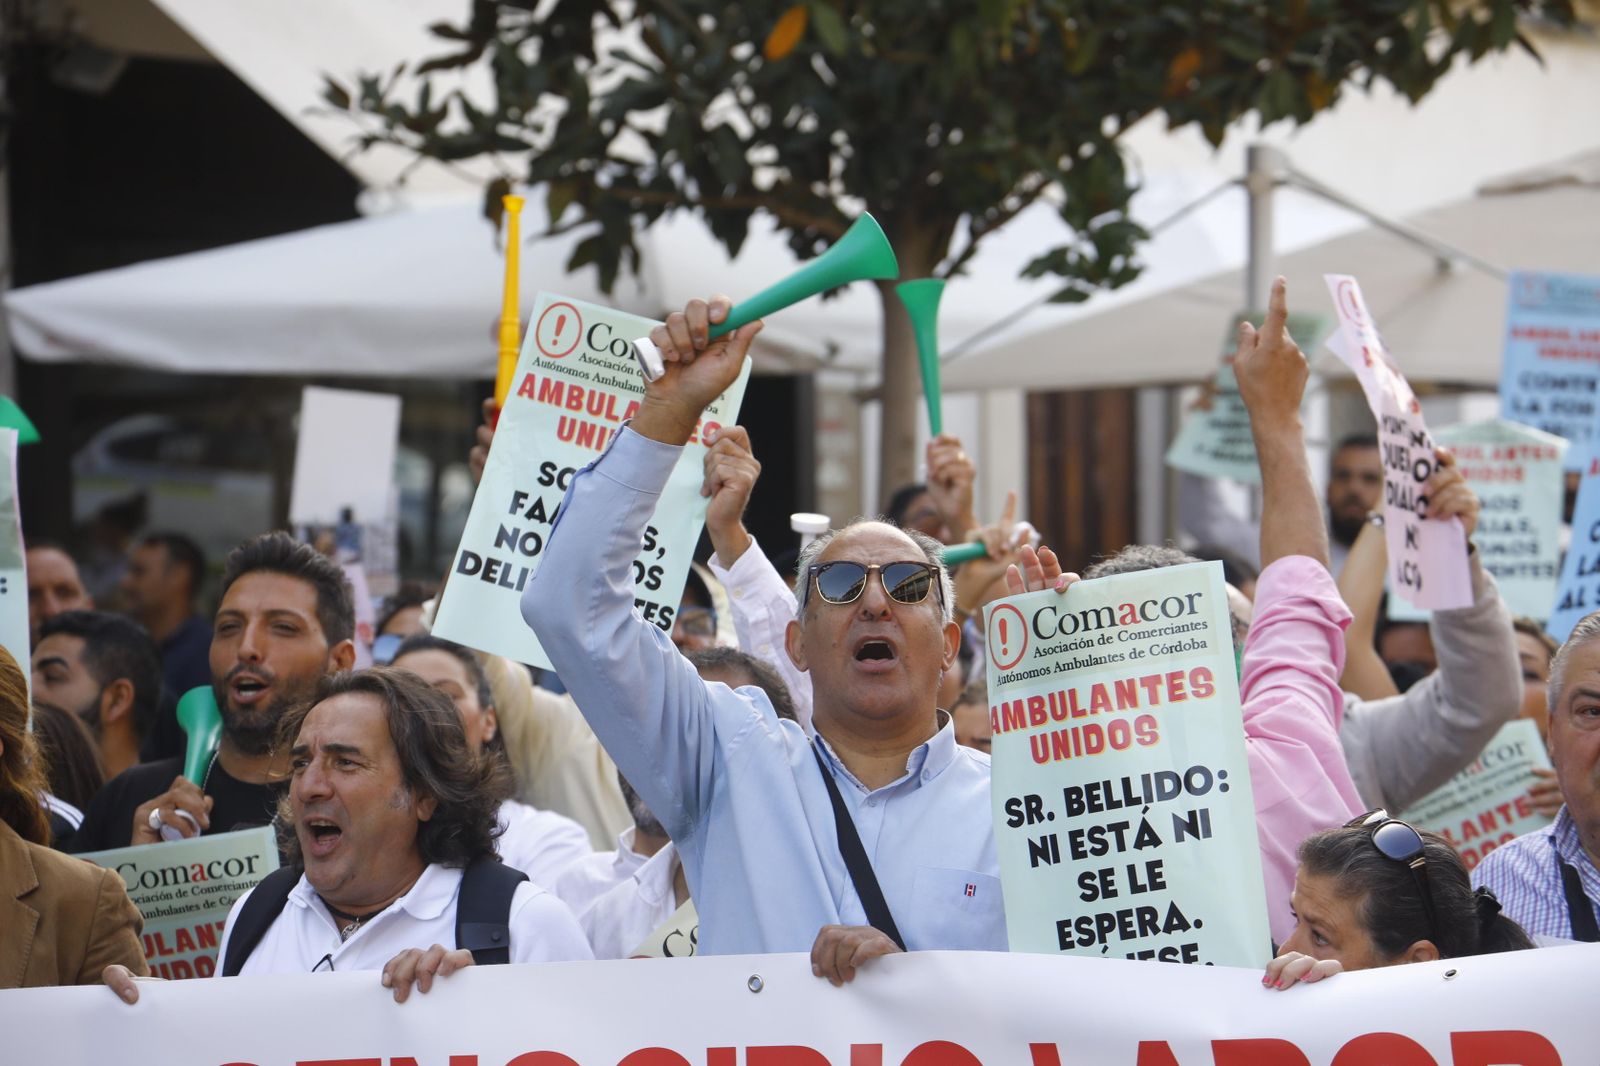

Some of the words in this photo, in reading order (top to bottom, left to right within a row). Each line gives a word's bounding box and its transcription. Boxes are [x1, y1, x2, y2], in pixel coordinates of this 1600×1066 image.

[531, 356, 590, 381] Autónomos
[579, 351, 634, 376] Asociación
[1032, 592, 1203, 641] Comacor
[1033, 636, 1094, 659] Asociación
[1097, 632, 1114, 646] de
[1117, 620, 1208, 643] Comerciantes
[996, 666, 1051, 687] Autónomos
[1053, 653, 1125, 674] Ambulantes
[1129, 647, 1146, 660] de
[1149, 638, 1208, 656] Córdoba
[990, 666, 1216, 735] AMBULANTES
[1029, 714, 1161, 766] UNIDOS
[1004, 793, 1056, 829] SR.
[1063, 765, 1230, 818] BELLIDO:
[1028, 834, 1061, 868] NI
[1068, 805, 1163, 861] ESTÁ
[1171, 807, 1213, 843] NI
[117, 854, 259, 892] Comacor
[175, 887, 189, 899] de
[1077, 867, 1119, 902] SE
[1126, 859, 1167, 895] LE
[203, 899, 217, 910] de
[1056, 900, 1203, 951] ESPERA.
